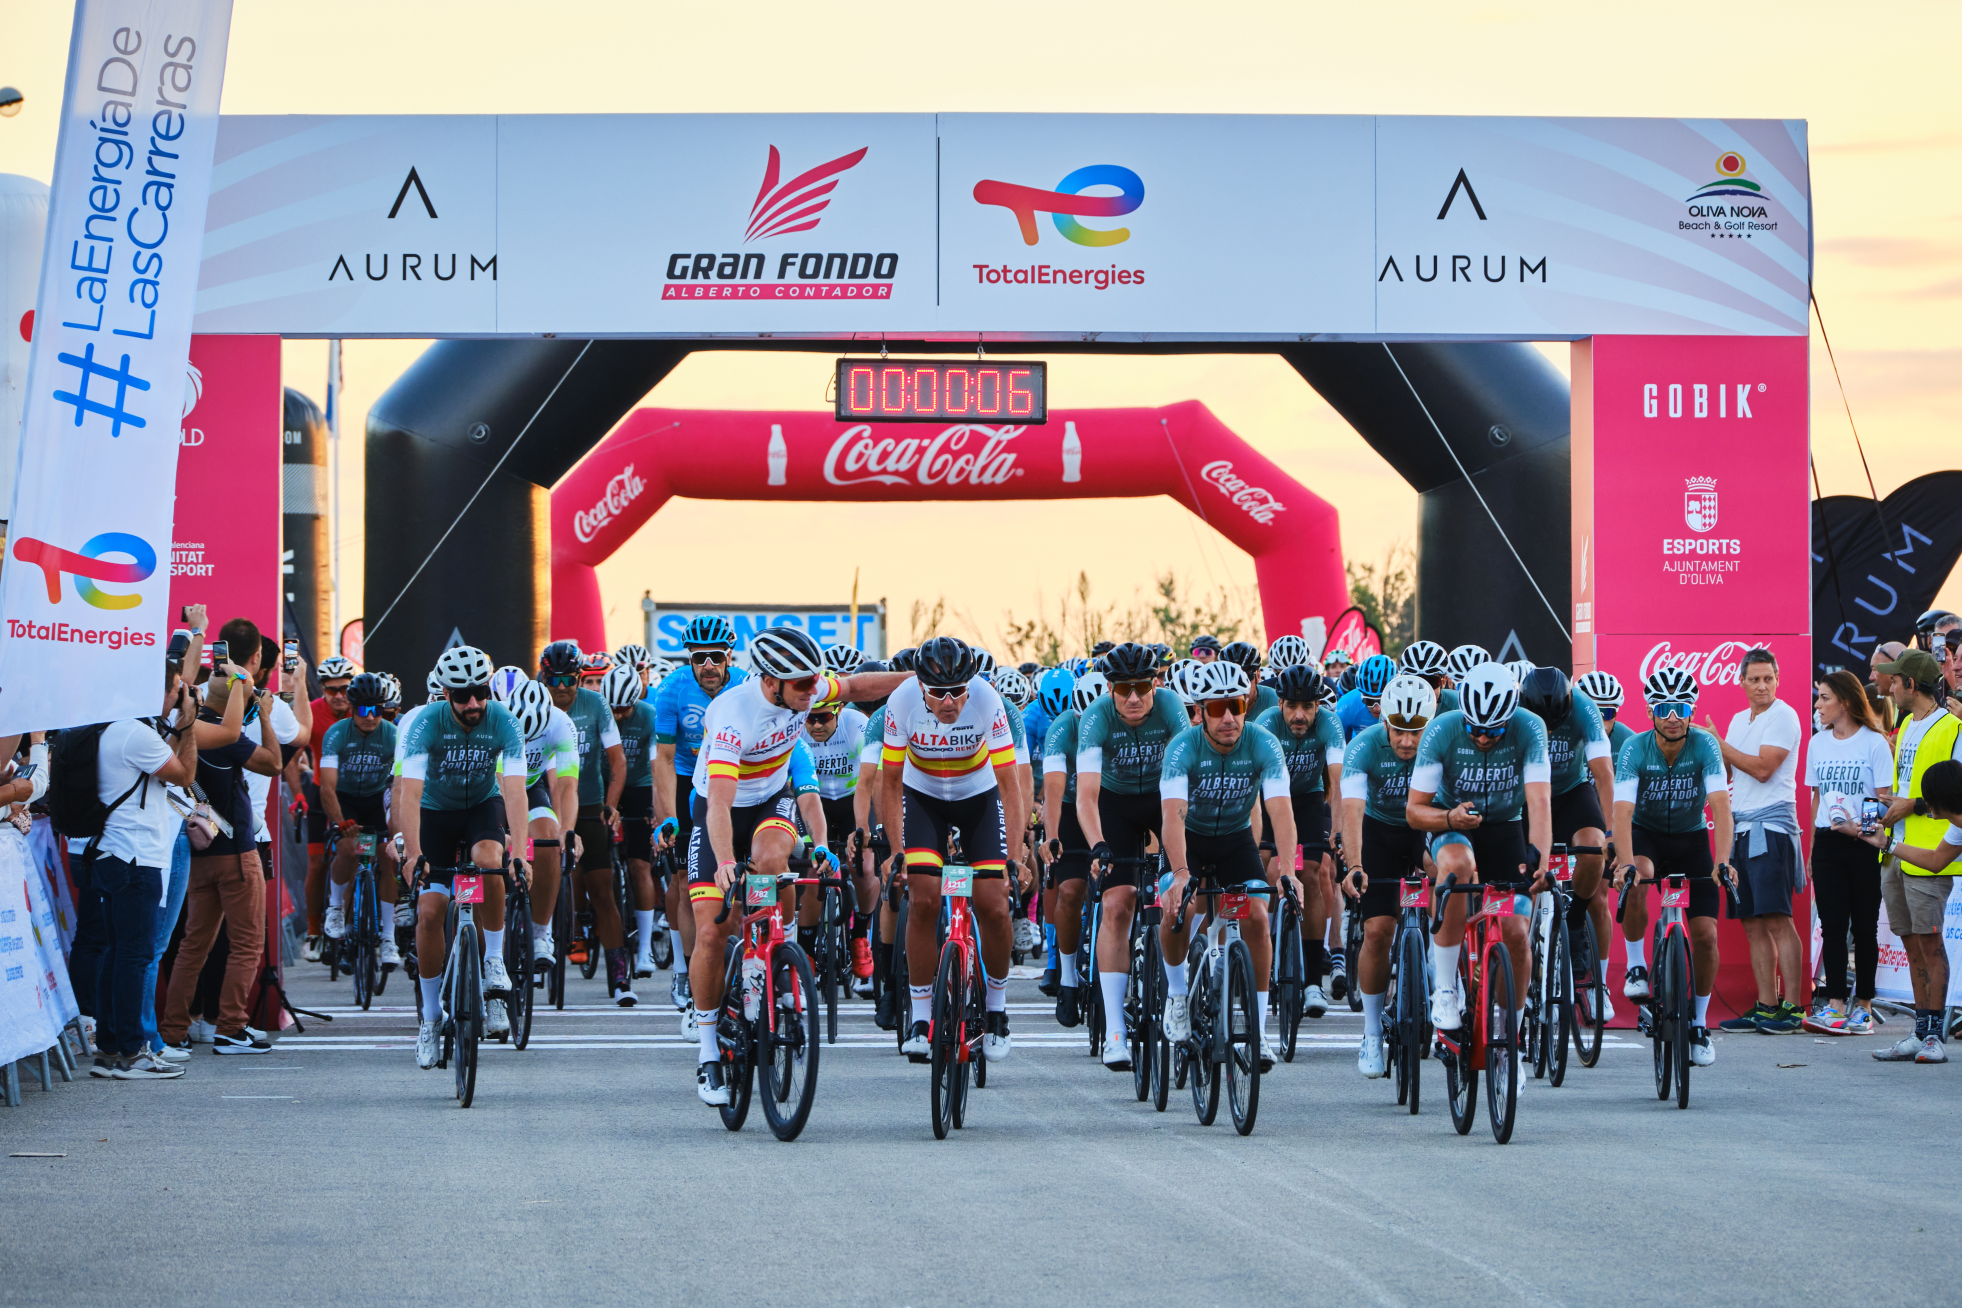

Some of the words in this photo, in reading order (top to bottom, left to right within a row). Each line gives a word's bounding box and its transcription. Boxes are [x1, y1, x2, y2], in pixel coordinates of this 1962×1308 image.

[113, 34, 196, 340] LasCarreras
[1689, 205, 1727, 217] OLIVA
[1730, 206, 1768, 218] NOVA
[1679, 220, 1711, 230] Beach
[1714, 221, 1721, 230] &
[1724, 221, 1745, 231] Golf
[1748, 221, 1778, 231] Resort
[328, 254, 497, 281] AURUM
[1378, 255, 1547, 283] AURUM
[972, 264, 1146, 290] TotalEnergies
[666, 286, 760, 297] ALBERTO
[775, 286, 888, 297] CONTADOR
[849, 367, 1032, 413] 00:00:06
[1643, 383, 1753, 418] GOBIK
[823, 424, 1017, 486] Coca-Cola
[1200, 460, 1286, 526] Coca-Cola
[574, 464, 647, 543] Coca-Cola
[171, 541, 205, 549] alenciana
[1662, 539, 1741, 555] ESPORTS
[170, 551, 205, 563] NITAT
[170, 564, 215, 576] SPORT
[1662, 561, 1741, 572] AJUNTAMENT
[1679, 574, 1724, 584] D'OLIVA
[1818, 523, 1933, 671] RUM
[7, 619, 156, 650] TotalEnergies
[1640, 641, 1771, 686] Coca-Co
[1008, 709, 1023, 734] AURUM
[1585, 705, 1602, 730] AURUM
[411, 718, 429, 746] AURUM
[1082, 713, 1098, 742] AURUM
[1527, 720, 1545, 748] AURUM
[716, 731, 742, 749] ALTA
[1422, 724, 1442, 755] AURUM
[1111, 752, 1164, 765] CONTADO
[1170, 741, 1187, 767] AURUM
[1266, 738, 1283, 765] AURUM
[1347, 741, 1366, 766] AURUM
[816, 764, 854, 776] NTADOR
[1460, 765, 1514, 781] ALBERTO
[1816, 766, 1861, 781] ALBERTO
[1198, 777, 1250, 790] ALBERTO
[1383, 776, 1413, 788] ALBE
[1455, 775, 1519, 793] CONTADOR
[1647, 777, 1693, 792] ALBERTO
[1191, 785, 1253, 800] CONTADOR
[1642, 787, 1698, 801] CONTADOR
[754, 890, 769, 898] 782
[948, 881, 966, 889] 1215
